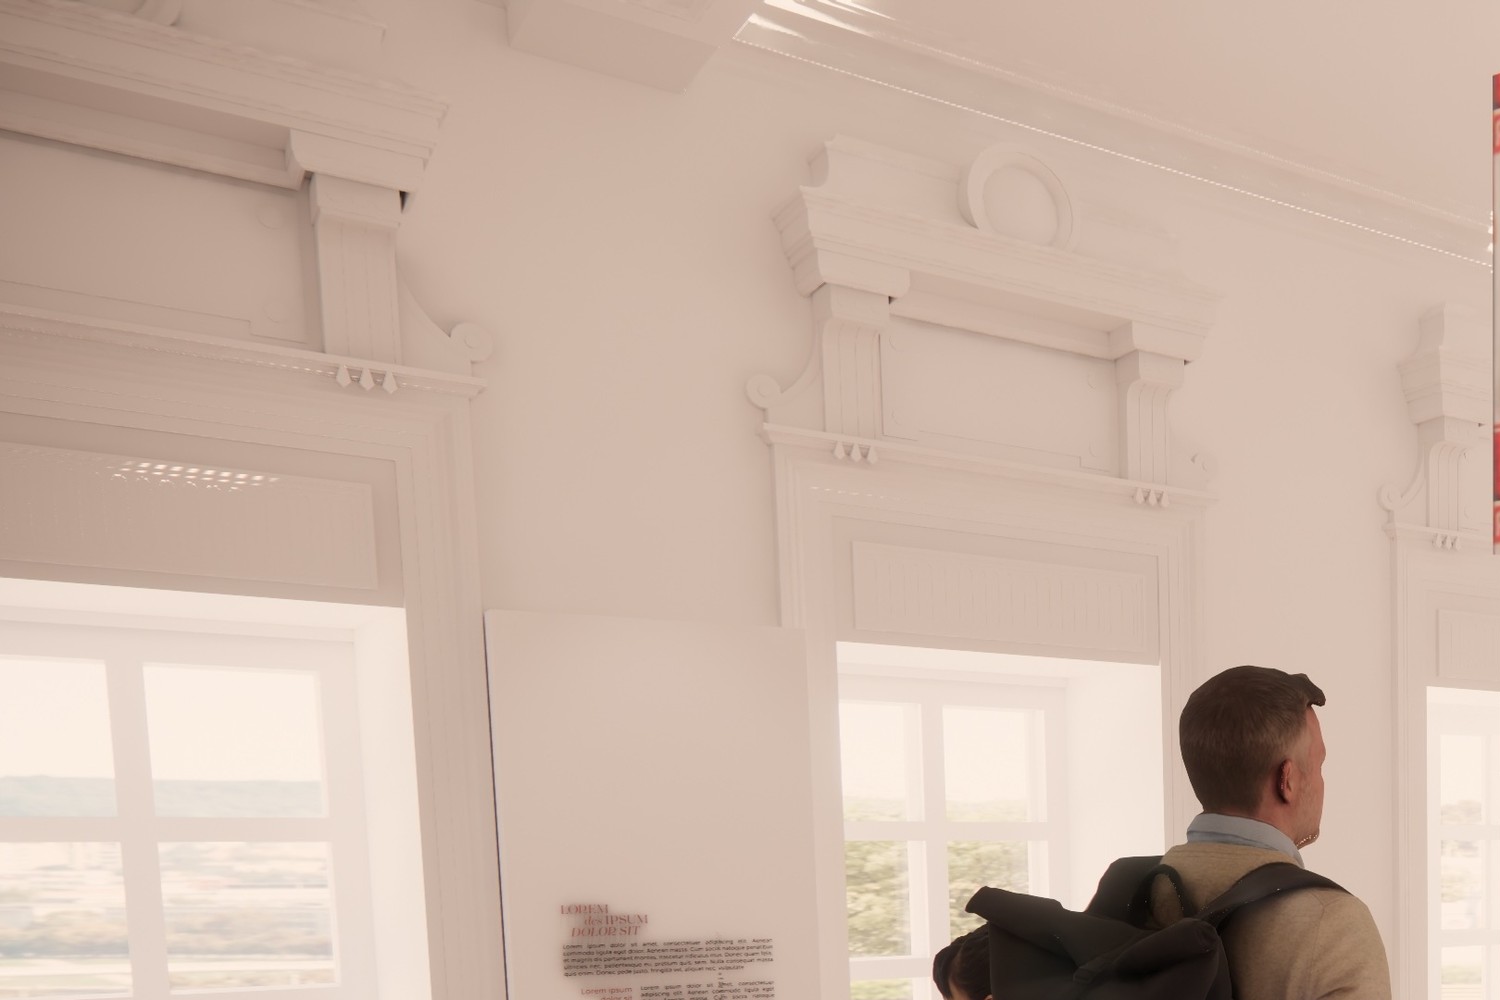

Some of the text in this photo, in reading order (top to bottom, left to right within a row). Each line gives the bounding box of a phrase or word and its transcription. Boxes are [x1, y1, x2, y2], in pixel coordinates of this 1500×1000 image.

[561, 904, 608, 914] LOREM
[606, 914, 648, 924] IPSUM
[572, 926, 640, 936] DOLOR SIT
